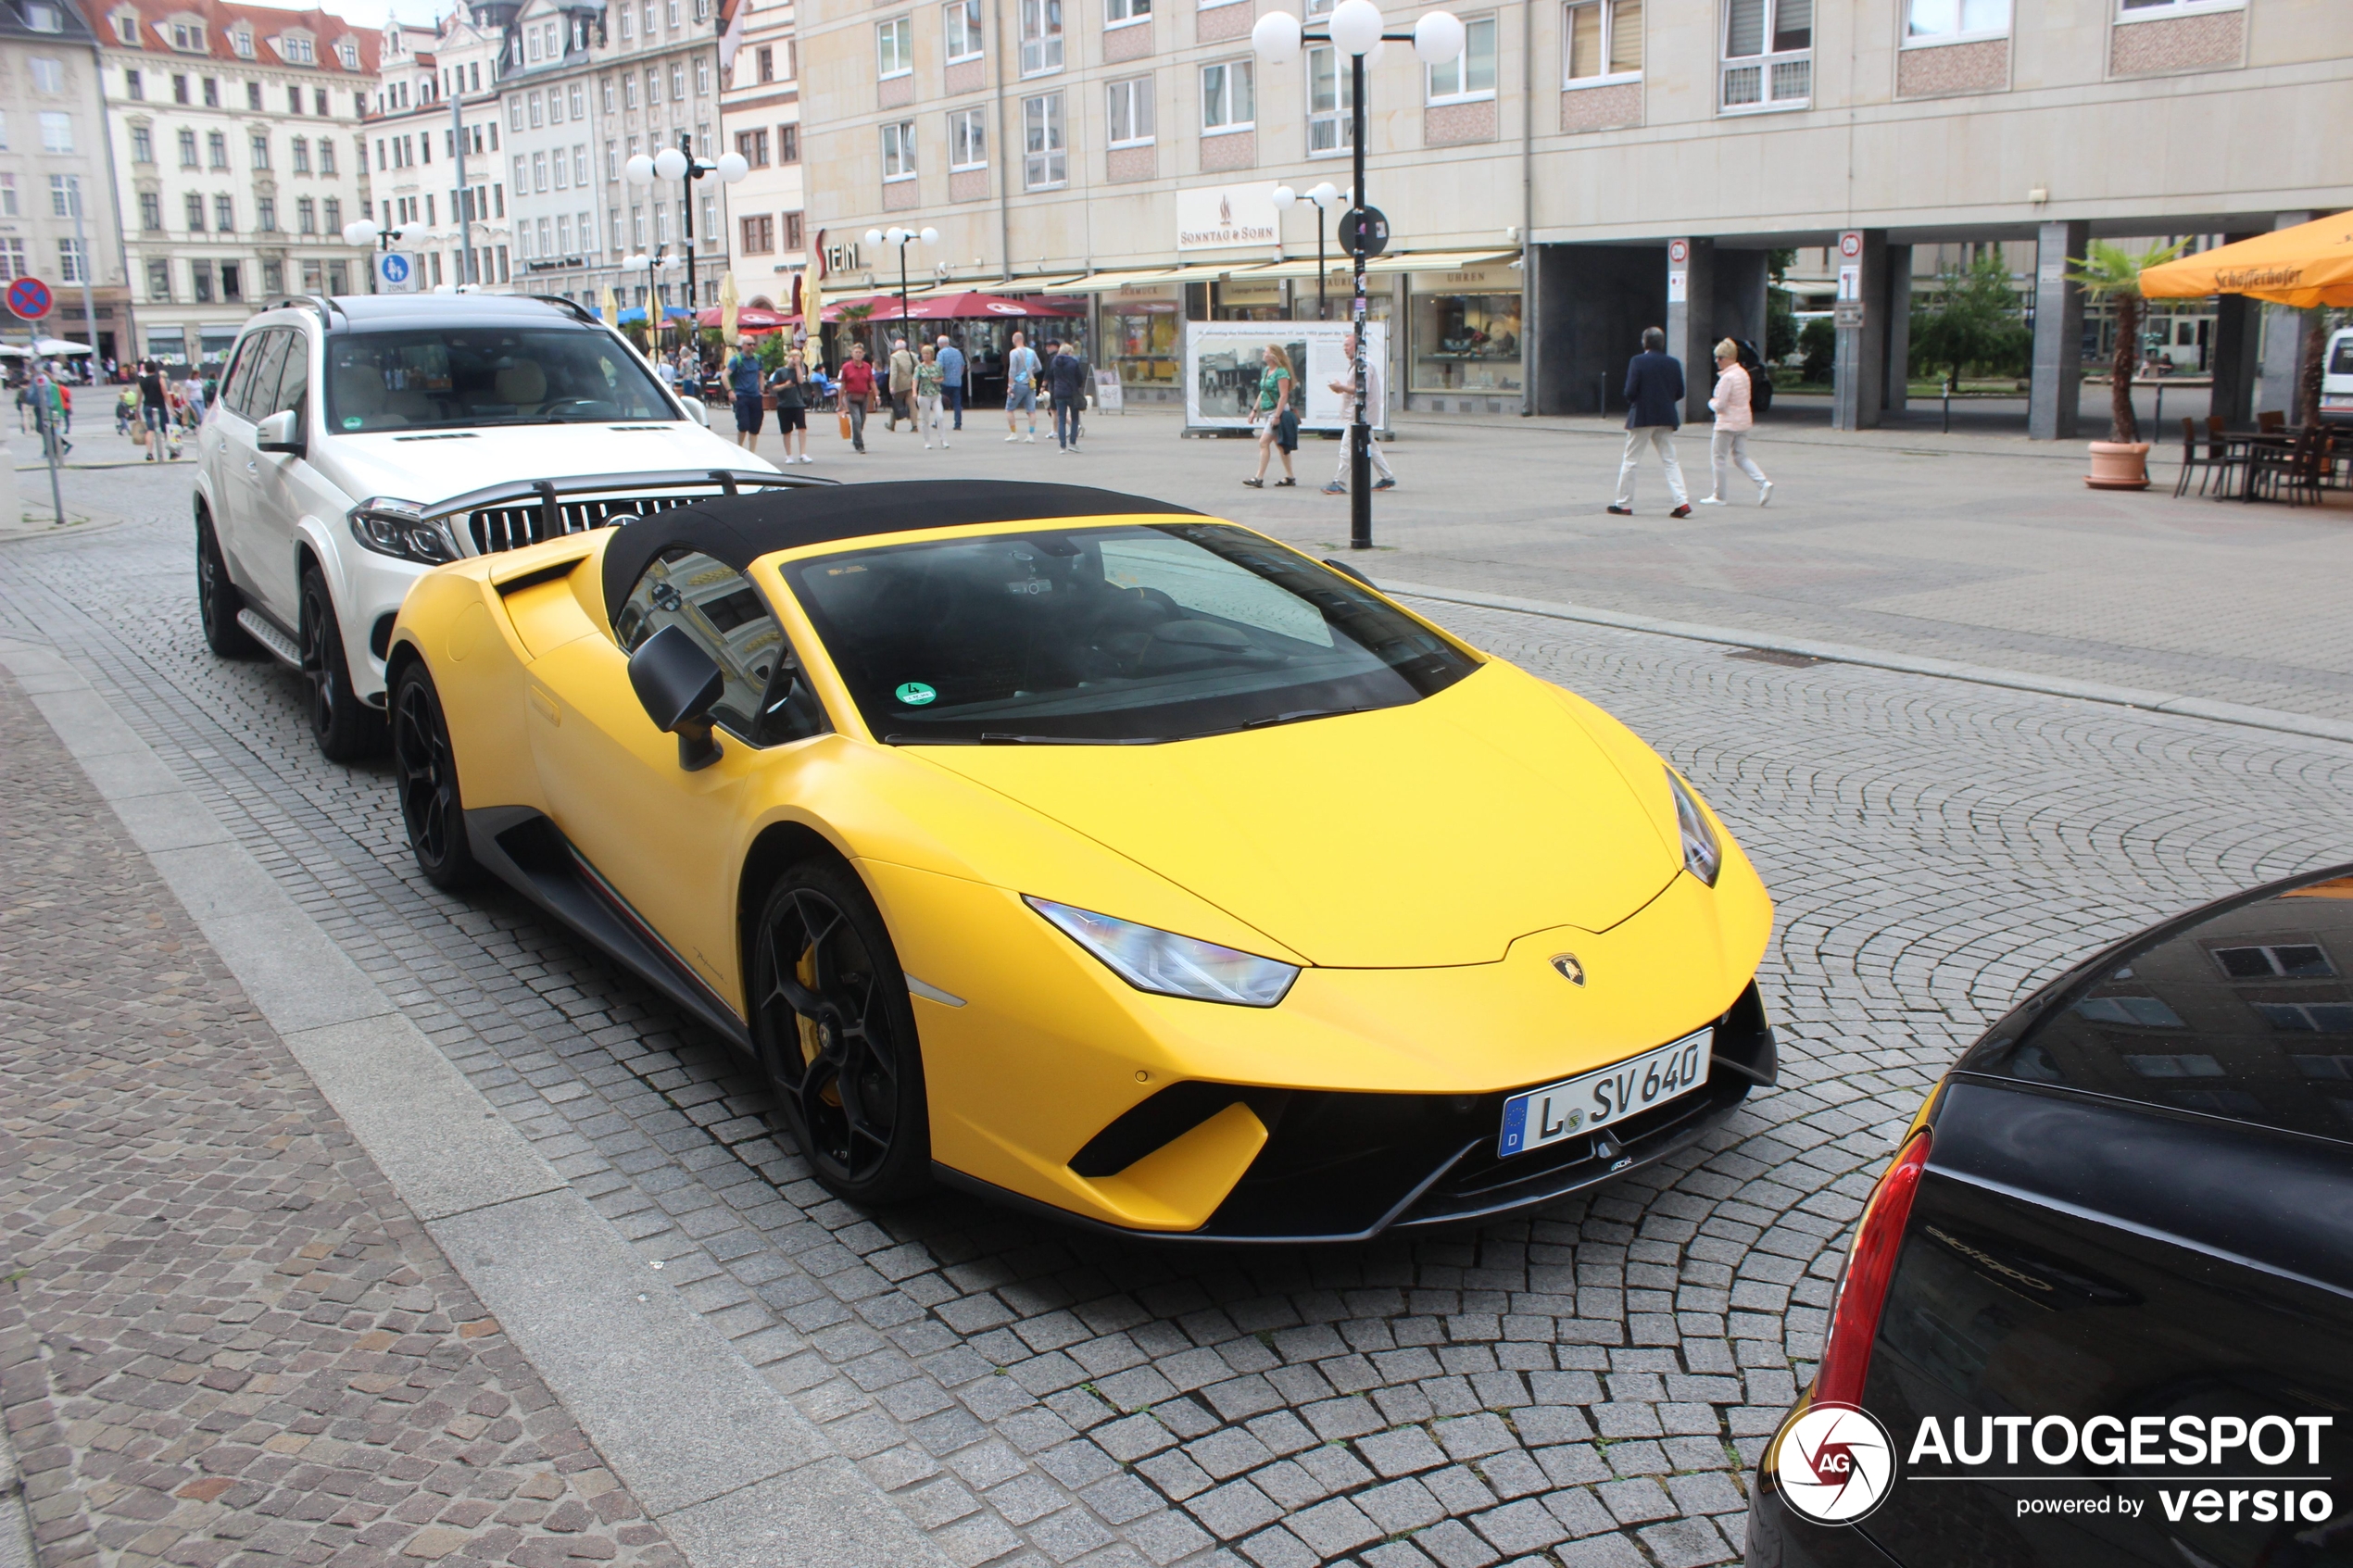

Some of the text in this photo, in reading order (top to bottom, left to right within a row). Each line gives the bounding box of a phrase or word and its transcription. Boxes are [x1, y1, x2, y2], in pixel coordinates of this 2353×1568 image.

[1180, 226, 1274, 245] SONNTAG & SOHN
[815, 228, 859, 281] STEIN
[1447, 271, 1486, 283] UHREN
[2214, 265, 2304, 290] Schöfferhofer
[387, 283, 407, 293] ZONE
[907, 683, 920, 694] 4
[1540, 1043, 1699, 1140] L SV 640
[1508, 1133, 1518, 1148] D
